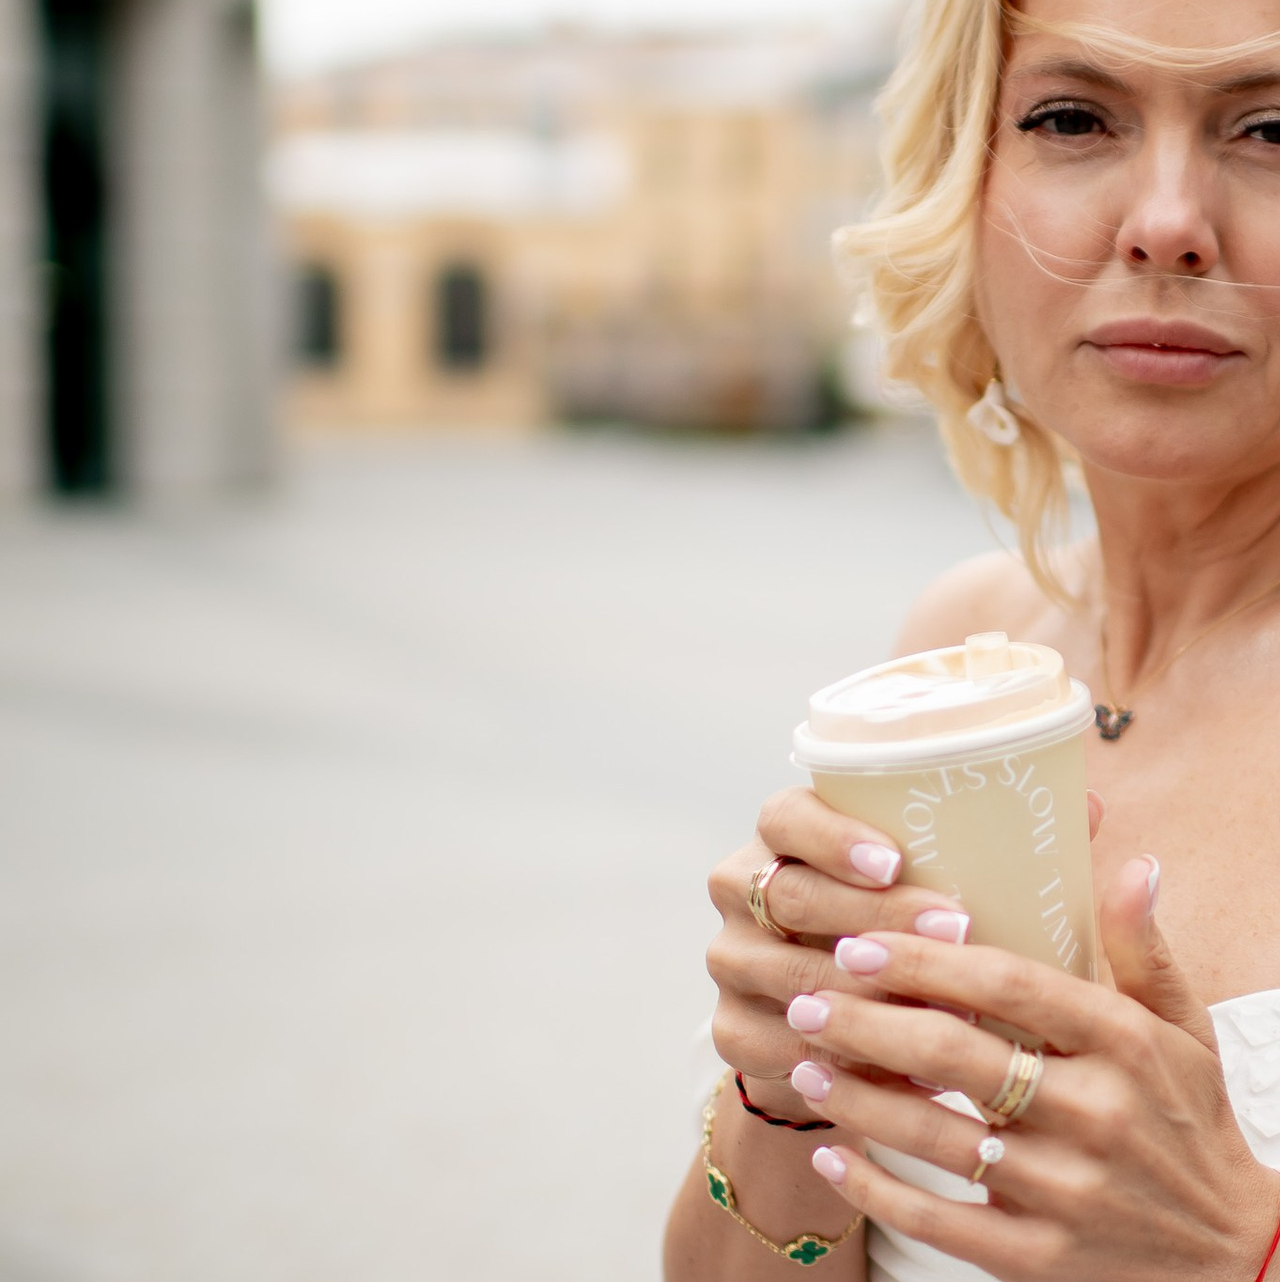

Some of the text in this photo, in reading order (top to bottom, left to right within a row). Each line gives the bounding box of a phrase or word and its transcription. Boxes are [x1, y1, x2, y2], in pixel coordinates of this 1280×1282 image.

[903, 754, 1082, 973] MOVES SLOW TIME
